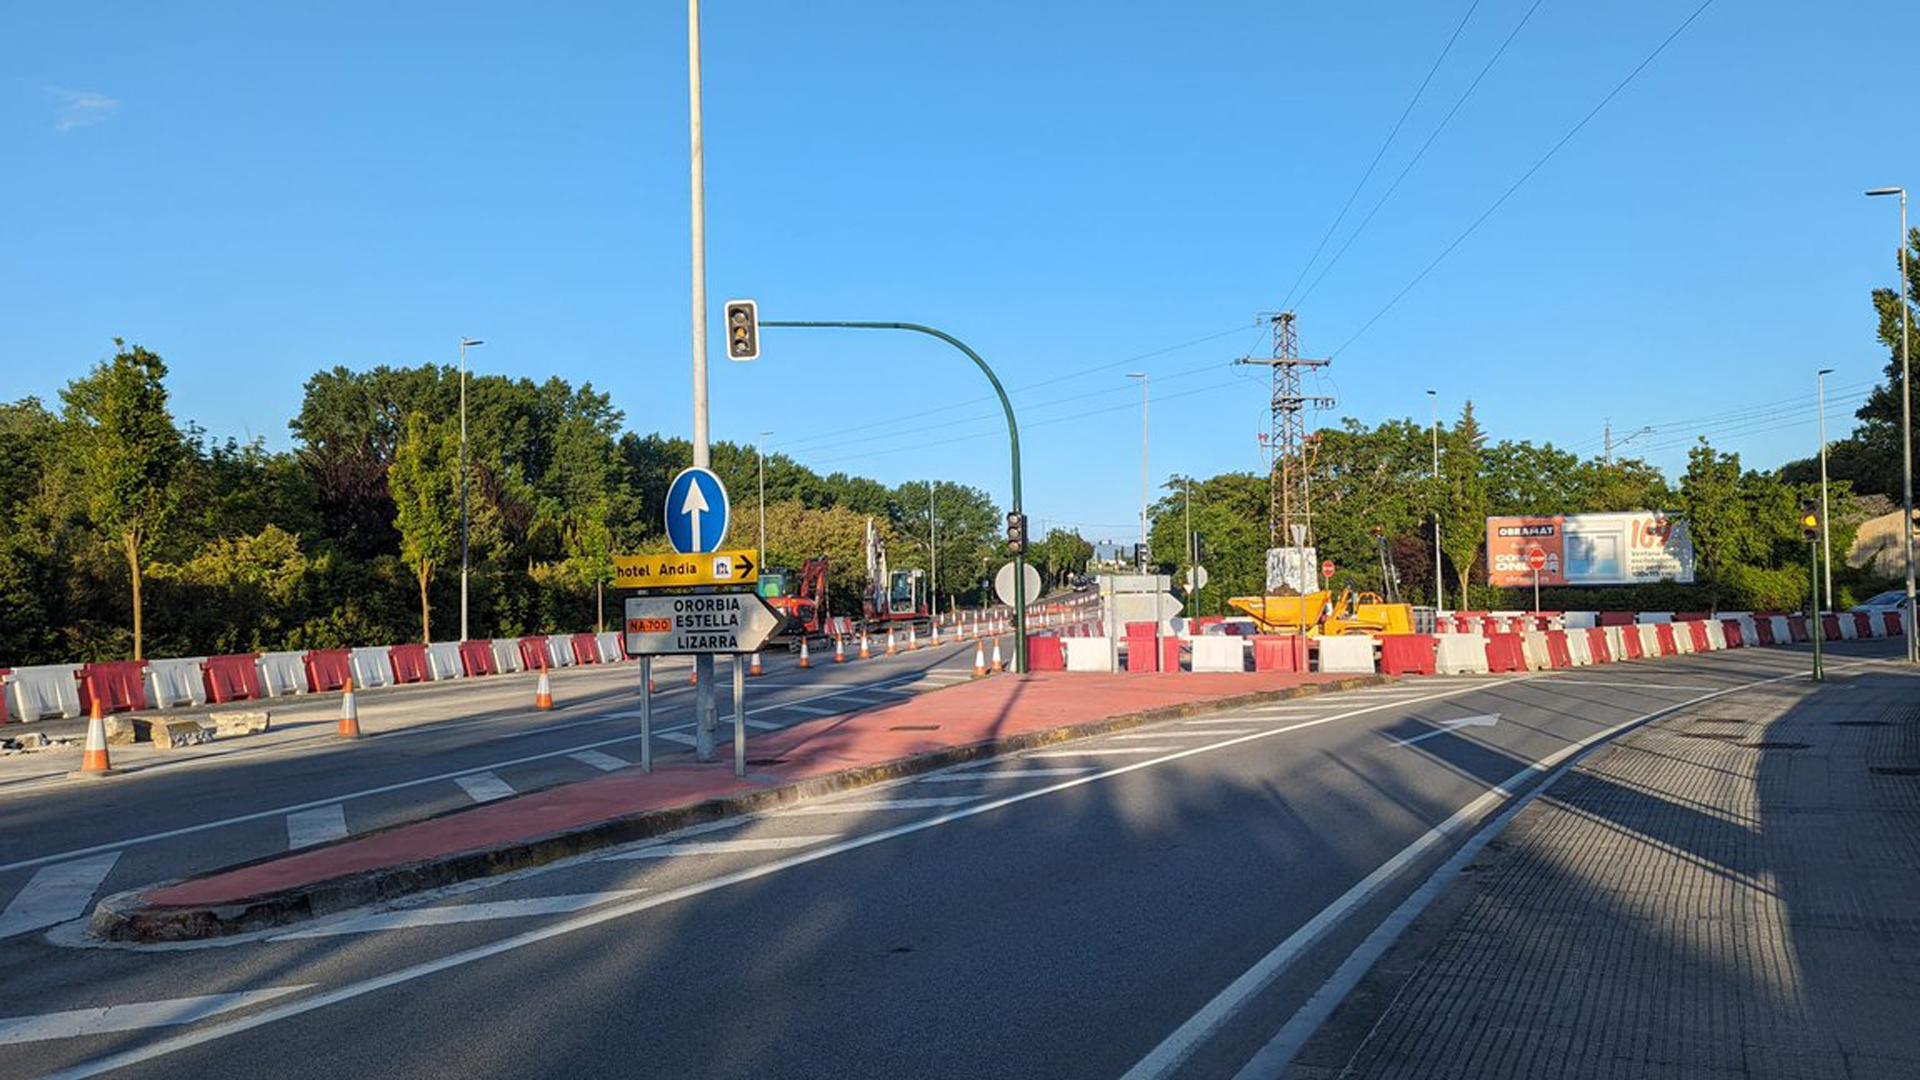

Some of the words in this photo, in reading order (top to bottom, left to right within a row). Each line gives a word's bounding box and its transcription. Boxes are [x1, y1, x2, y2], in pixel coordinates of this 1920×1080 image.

[1499, 526, 1553, 536] OBRAMAT
[616, 565, 650, 578] hotel
[659, 562, 697, 576] Andia
[674, 597, 740, 613] ORORBIA
[676, 613, 739, 628] ESTELLA
[677, 635, 738, 650] LIZARRA
